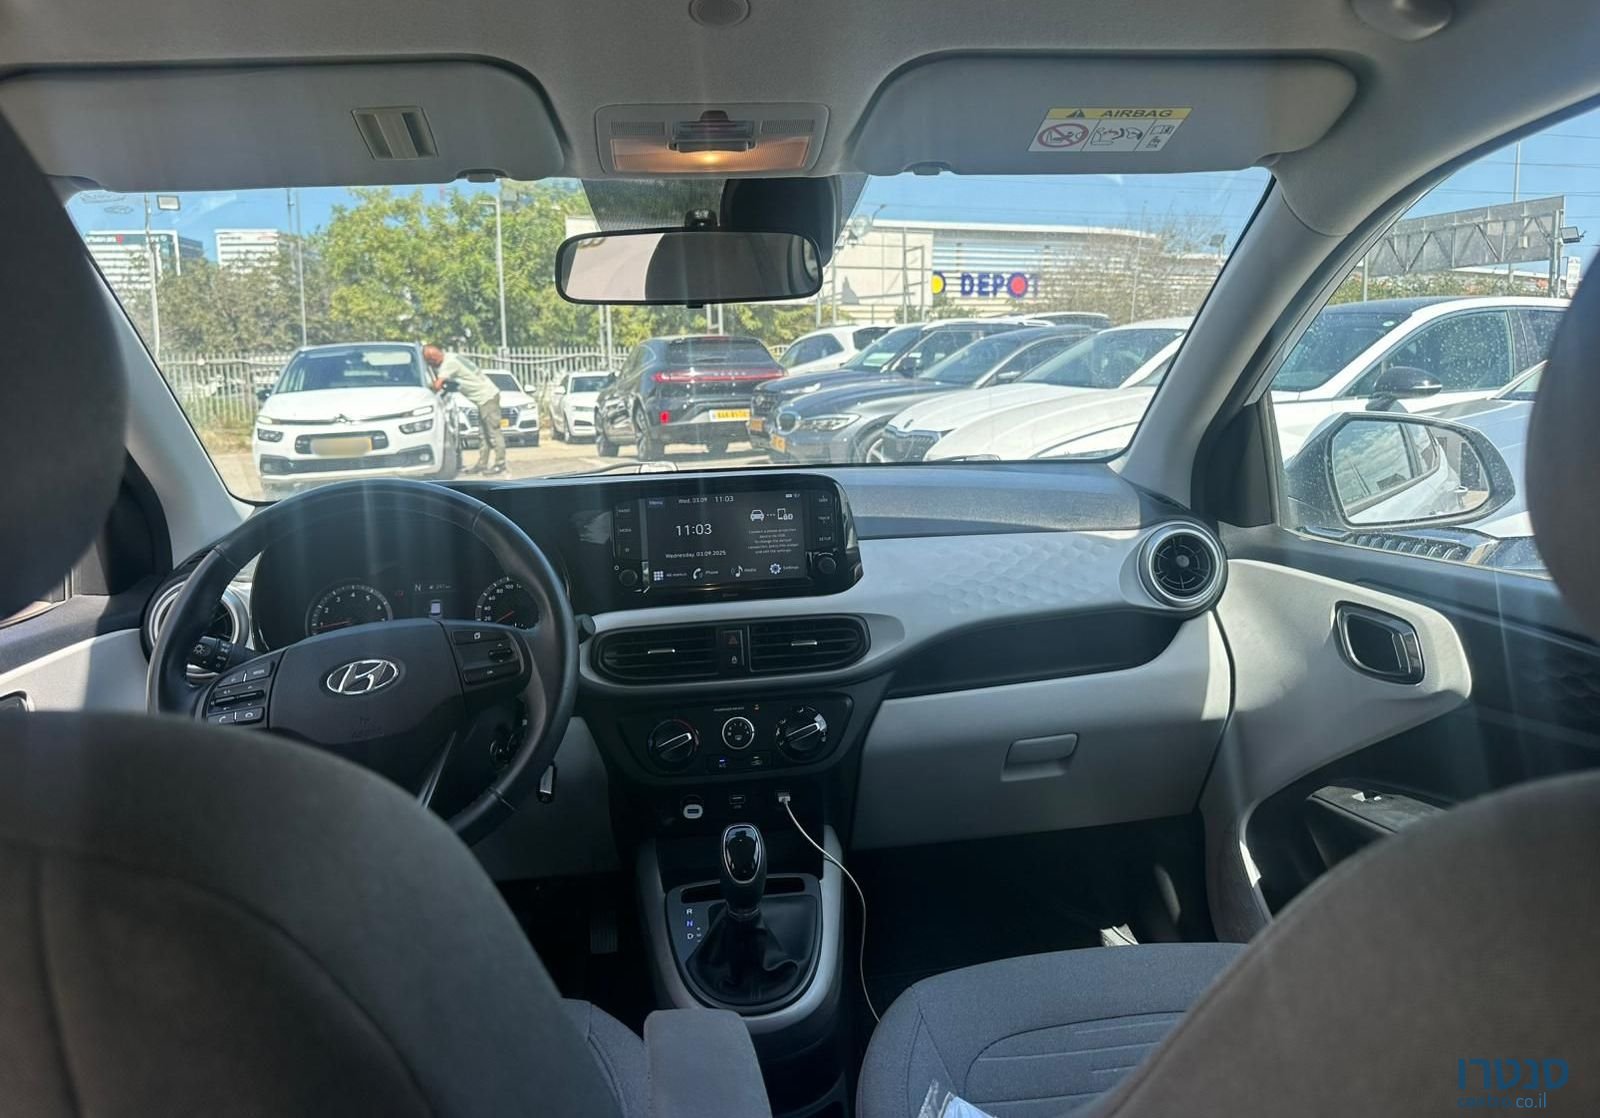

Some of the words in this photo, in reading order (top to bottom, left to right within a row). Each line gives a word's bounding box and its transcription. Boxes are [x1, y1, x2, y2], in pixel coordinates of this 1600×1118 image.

[1100, 109, 1173, 118] AIRBAG
[714, 495, 734, 503] 11:03
[675, 523, 713, 536] 11:03
